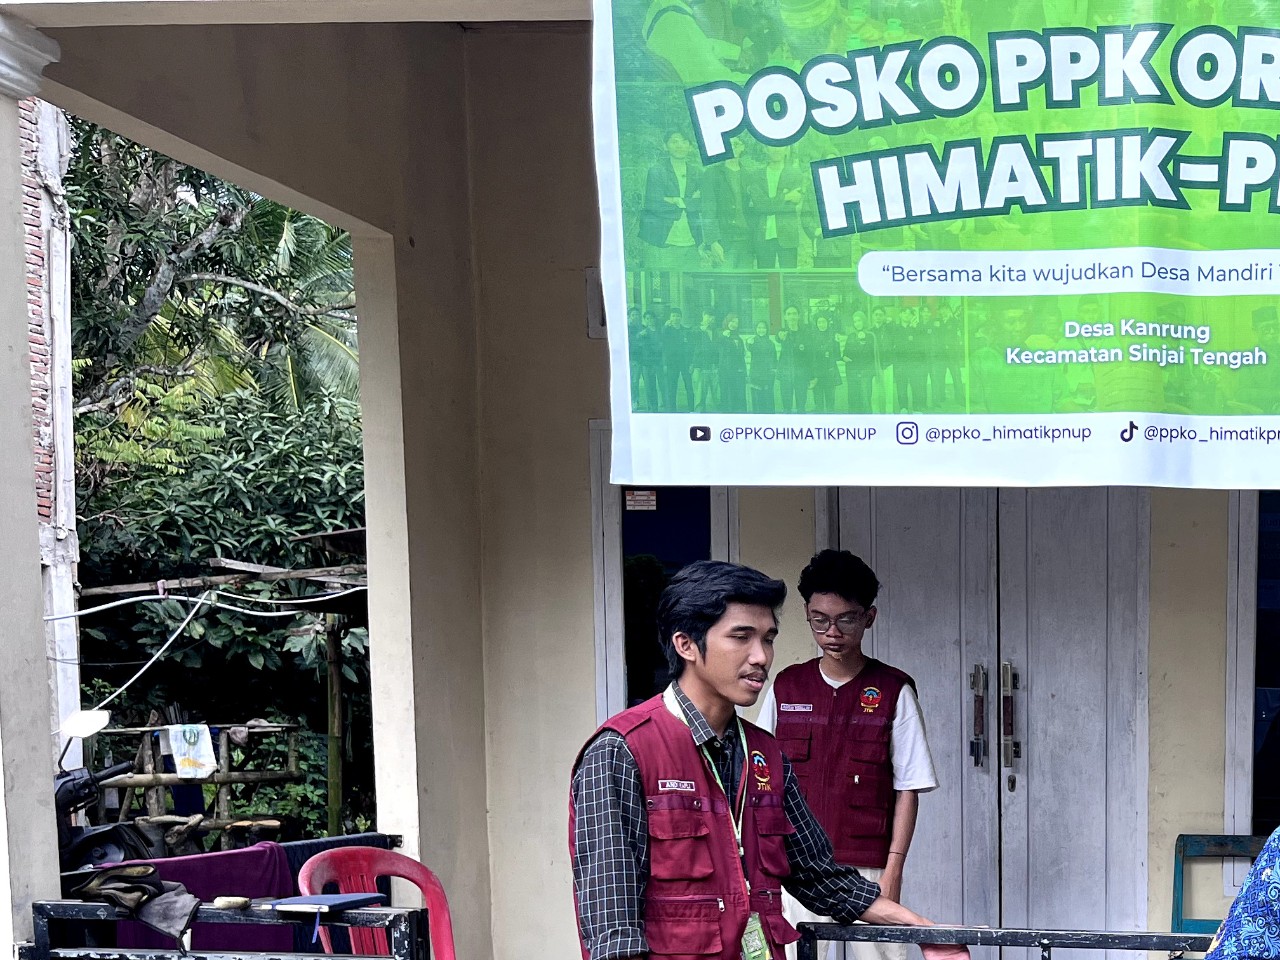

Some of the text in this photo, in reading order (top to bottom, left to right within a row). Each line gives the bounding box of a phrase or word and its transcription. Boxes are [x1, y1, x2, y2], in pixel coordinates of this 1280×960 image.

[689, 40, 983, 160] POSKO
[993, 29, 1163, 106] PPK
[989, 264, 1027, 283] kita
[1032, 262, 1134, 285] wujudkan
[1141, 261, 1190, 281] Desa
[1197, 263, 1273, 283] Mandiri
[1064, 319, 1211, 343] Desa Kanrung
[1006, 344, 1268, 369] Kecamatan Sinjai Tengah
[719, 426, 877, 442] @PPKOHIMATIKPNUP
[925, 425, 1092, 443] @ppko_himatikpnup
